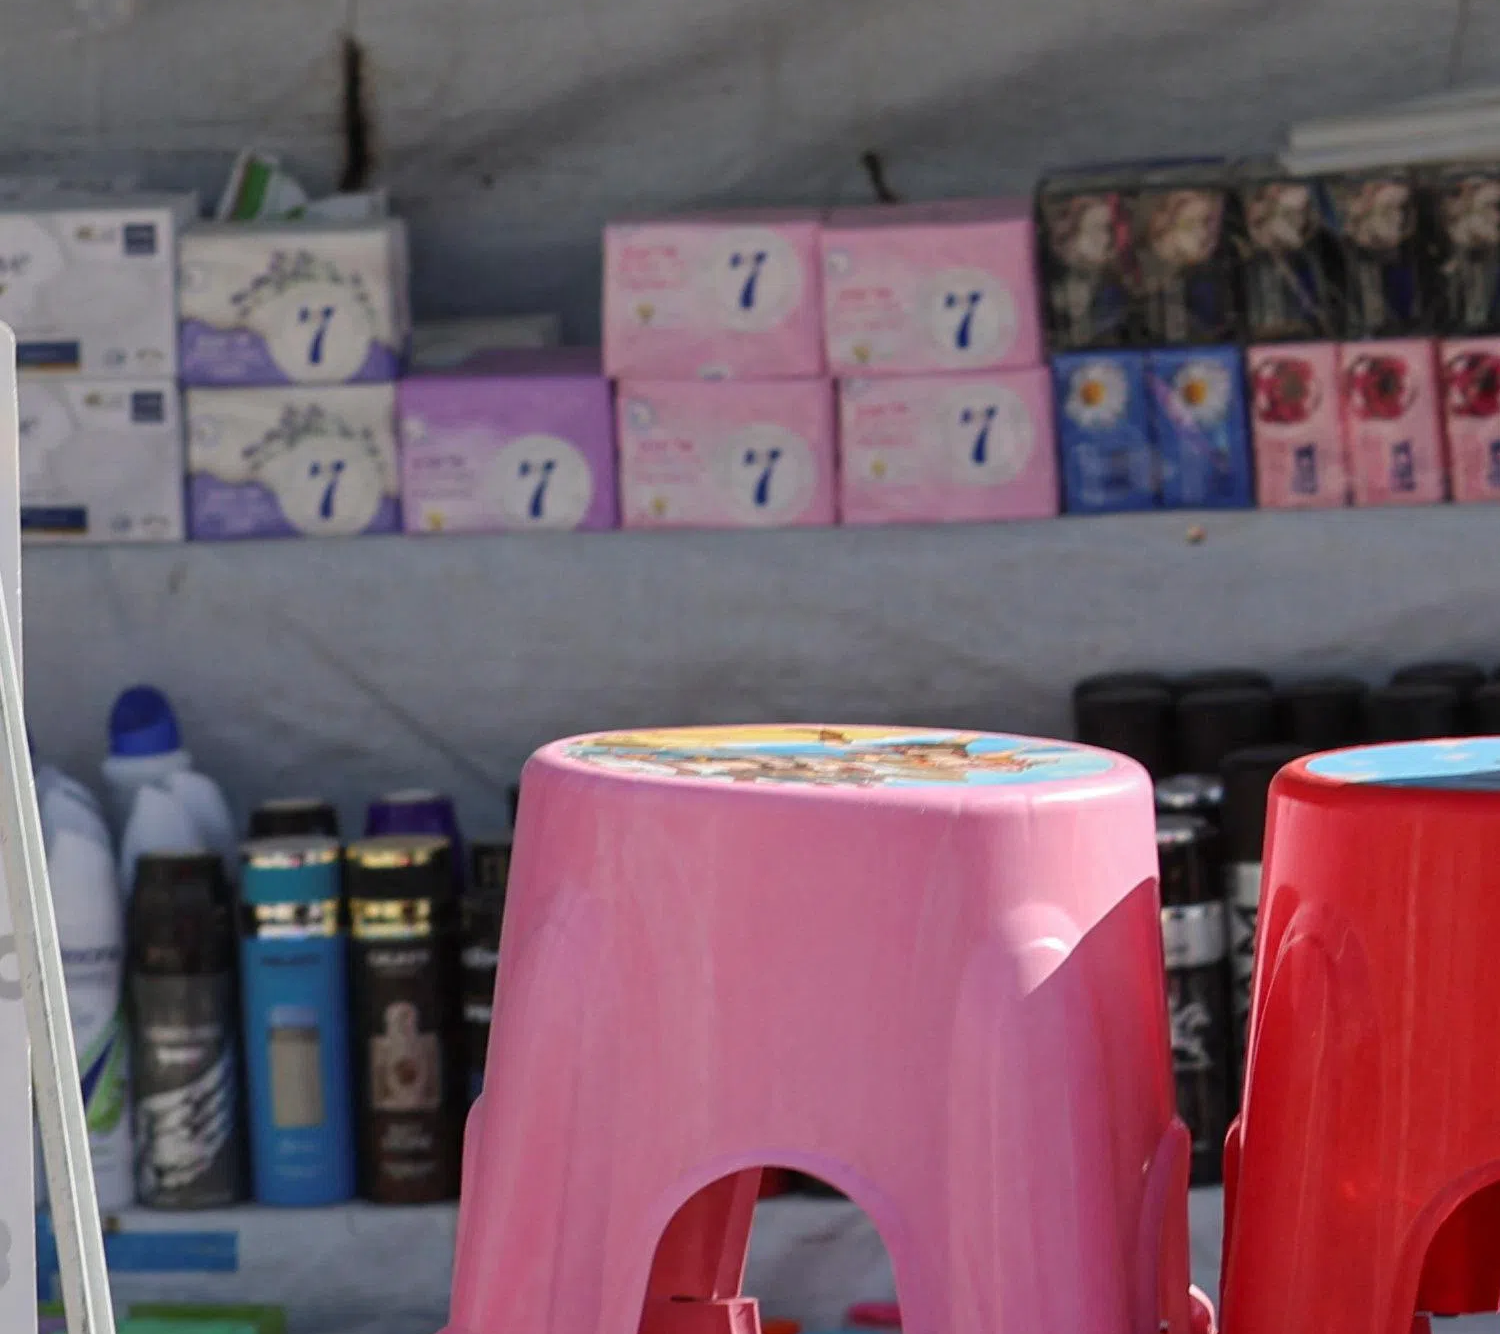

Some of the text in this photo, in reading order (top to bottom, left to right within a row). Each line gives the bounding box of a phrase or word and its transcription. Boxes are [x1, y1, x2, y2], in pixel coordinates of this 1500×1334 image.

[731, 251, 768, 309] 7
[300, 306, 335, 365] 7
[946, 291, 982, 350] 7
[521, 461, 556, 519] 7
[745, 449, 782, 507] 7
